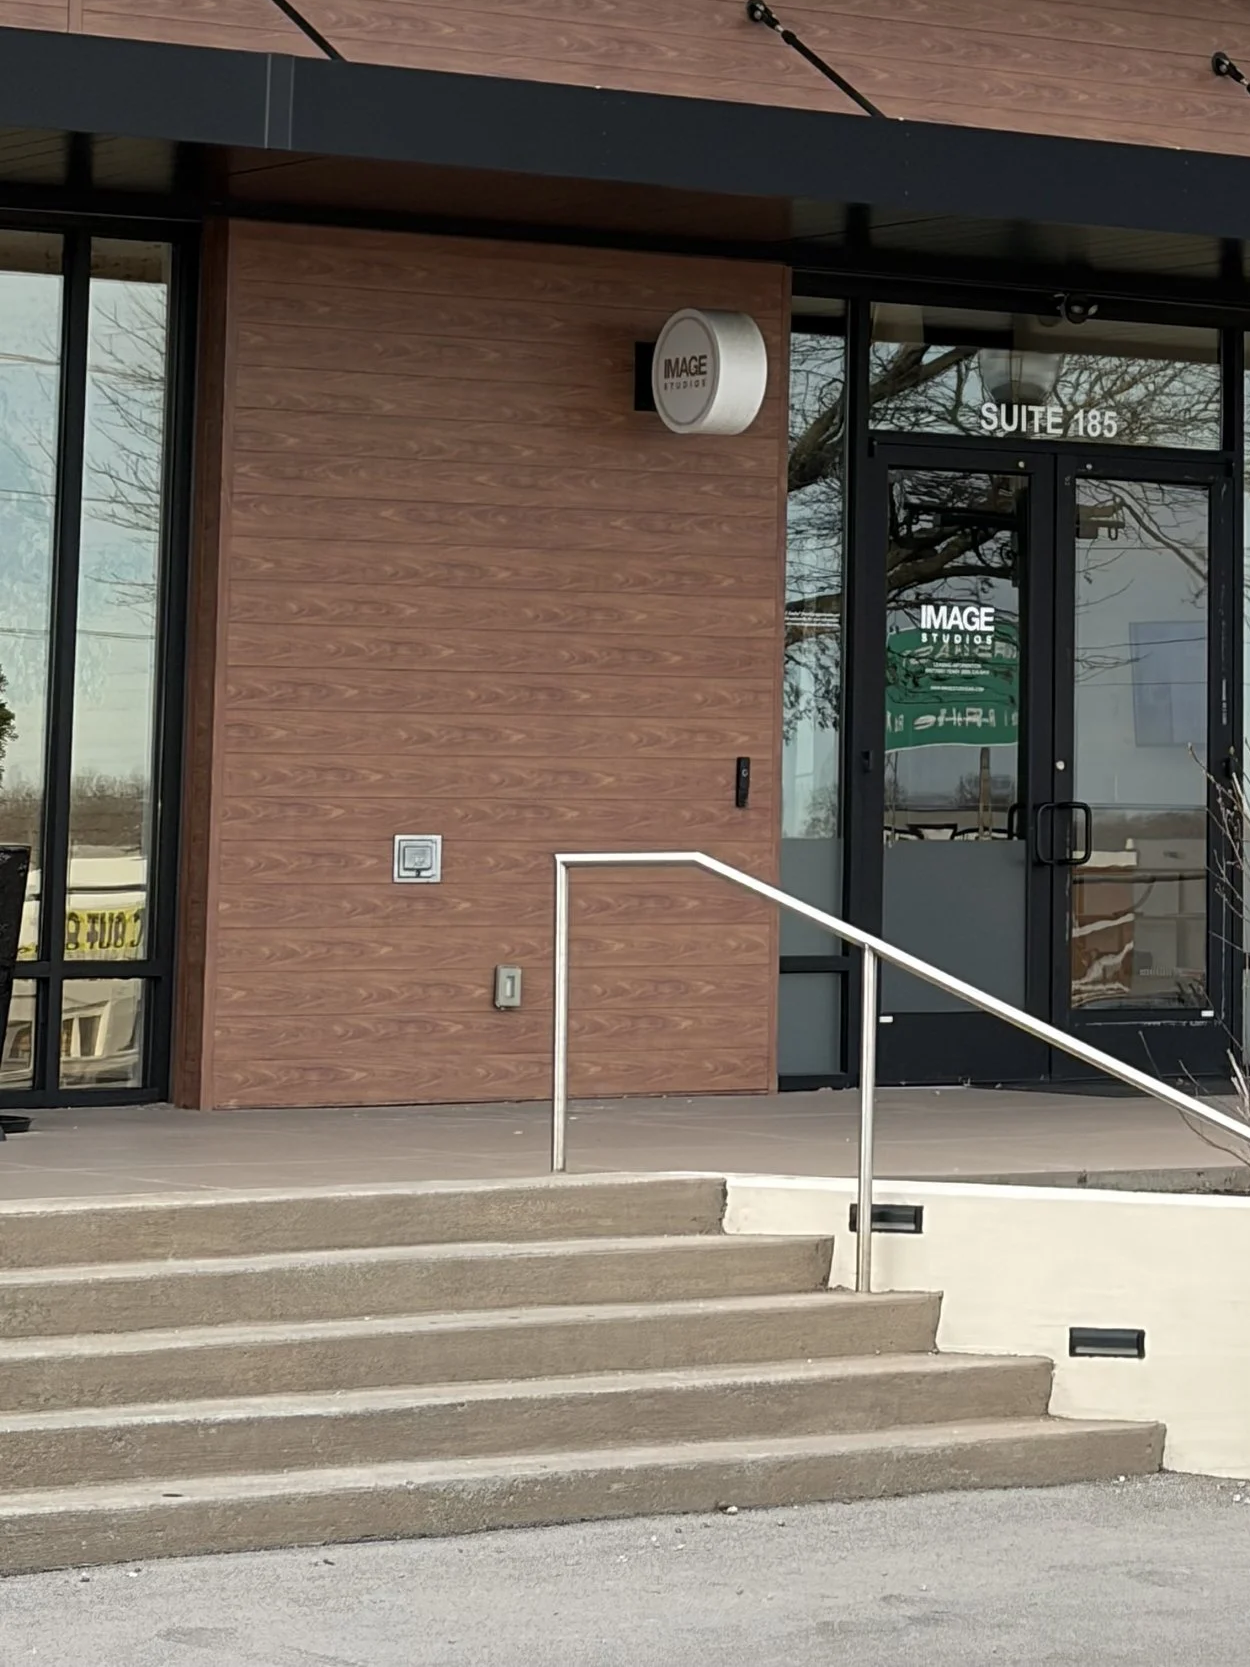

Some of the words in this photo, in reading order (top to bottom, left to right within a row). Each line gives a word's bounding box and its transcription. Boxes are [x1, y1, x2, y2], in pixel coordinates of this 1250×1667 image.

[663, 354, 708, 379] IMAGE
[664, 380, 706, 391] STUDIOS
[980, 401, 1064, 435] SUITE
[1073, 407, 1118, 439] 185
[920, 604, 995, 632] IMAGE
[921, 632, 993, 645] STUDIOS
